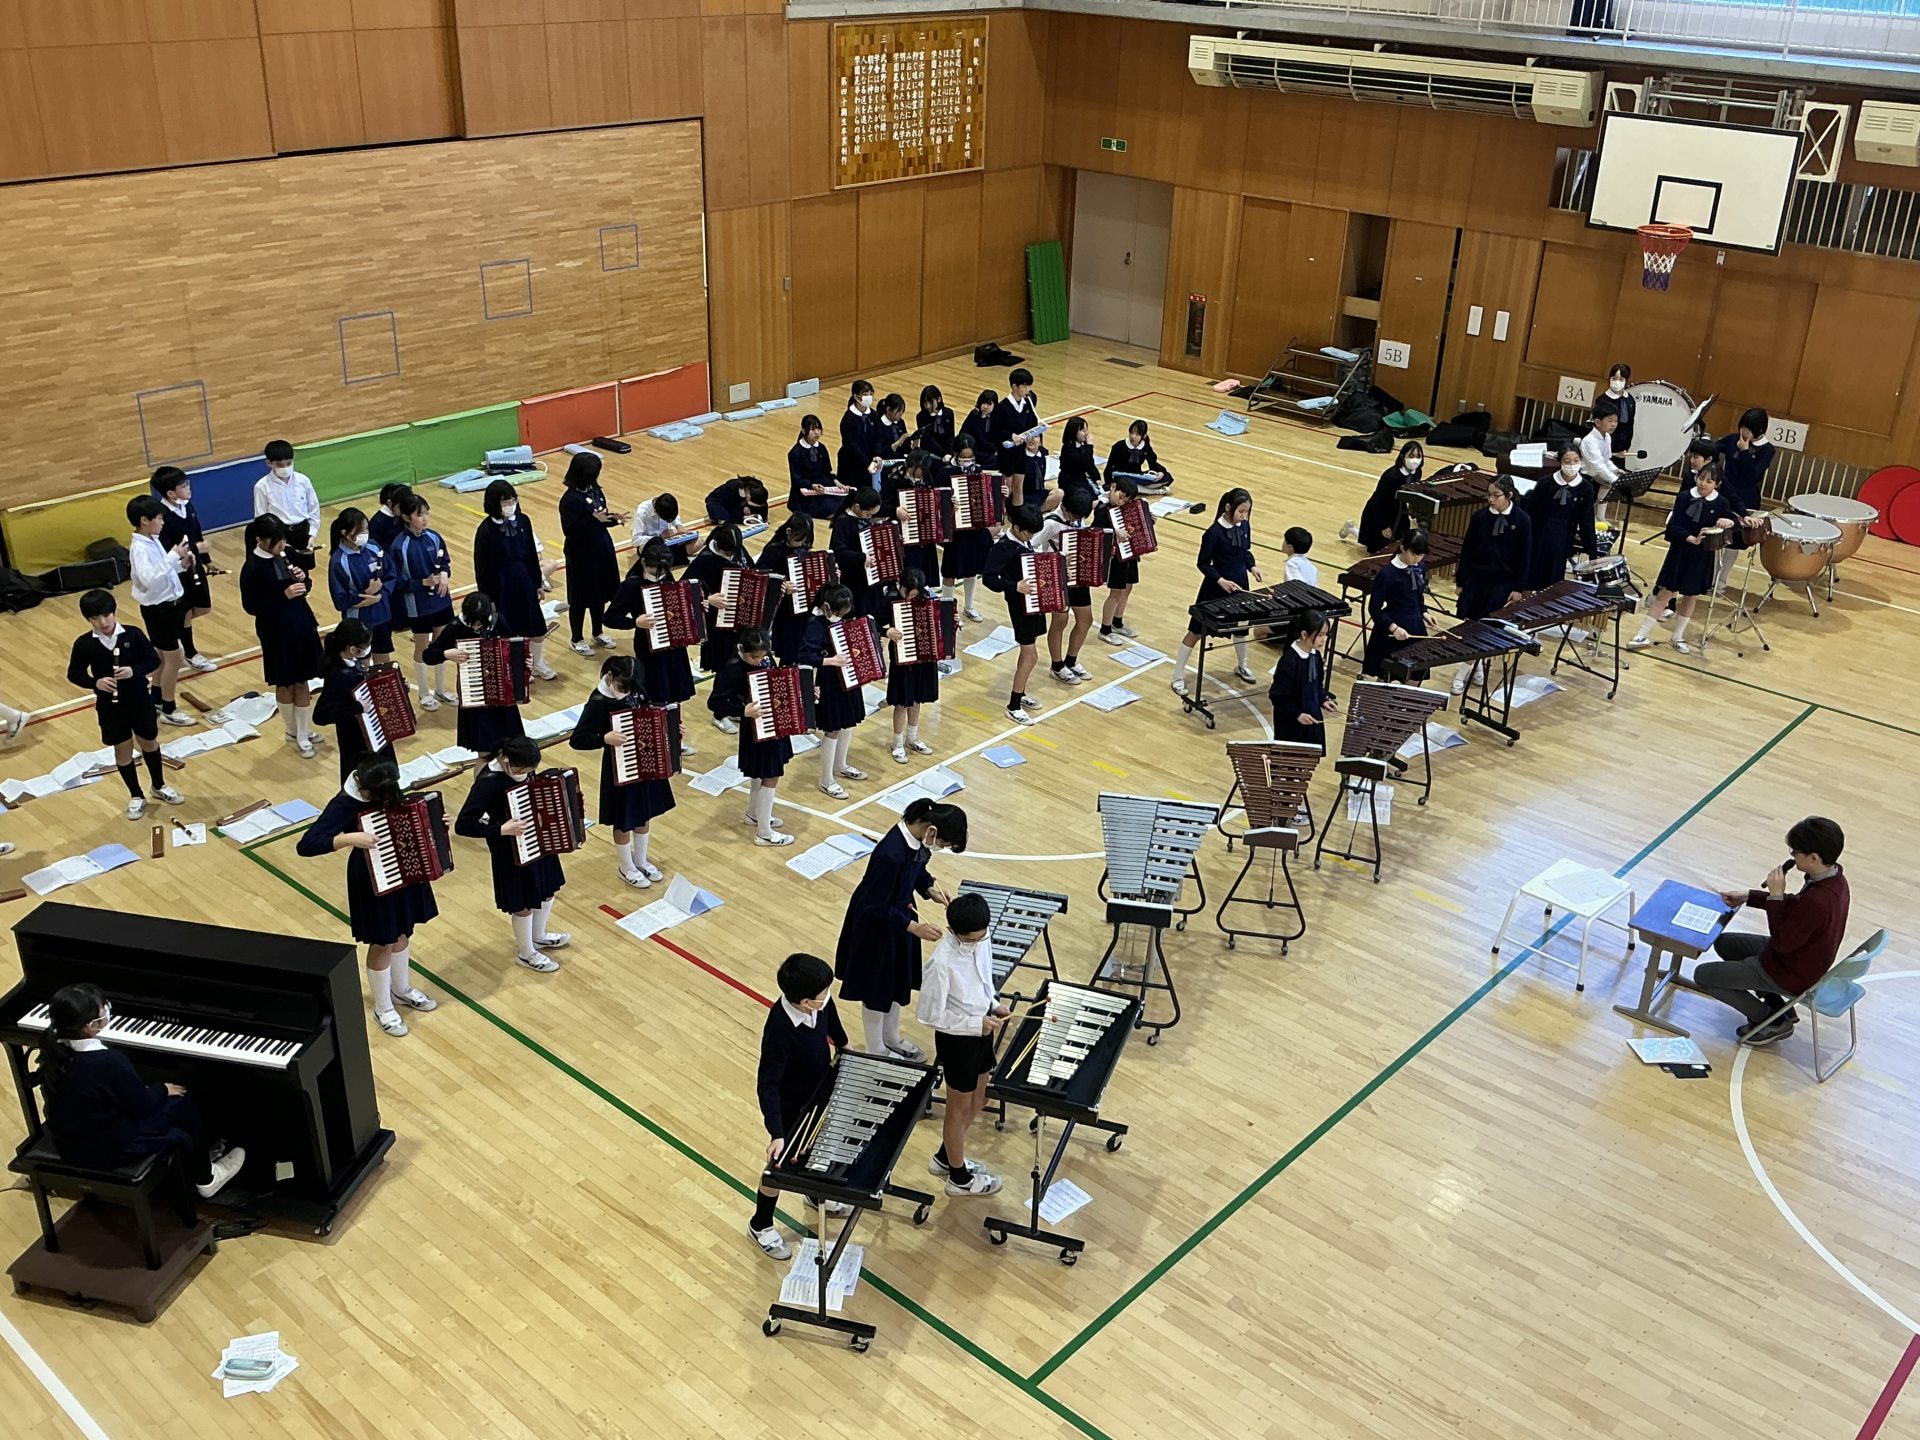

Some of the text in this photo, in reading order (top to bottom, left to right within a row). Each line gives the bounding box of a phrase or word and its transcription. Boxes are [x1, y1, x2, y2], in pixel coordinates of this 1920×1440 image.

[1384, 348, 1402, 363] 5B
[1565, 385, 1584, 401] 3A
[1643, 394, 1673, 406] YAMAHA
[1773, 427, 1796, 443] 3B
